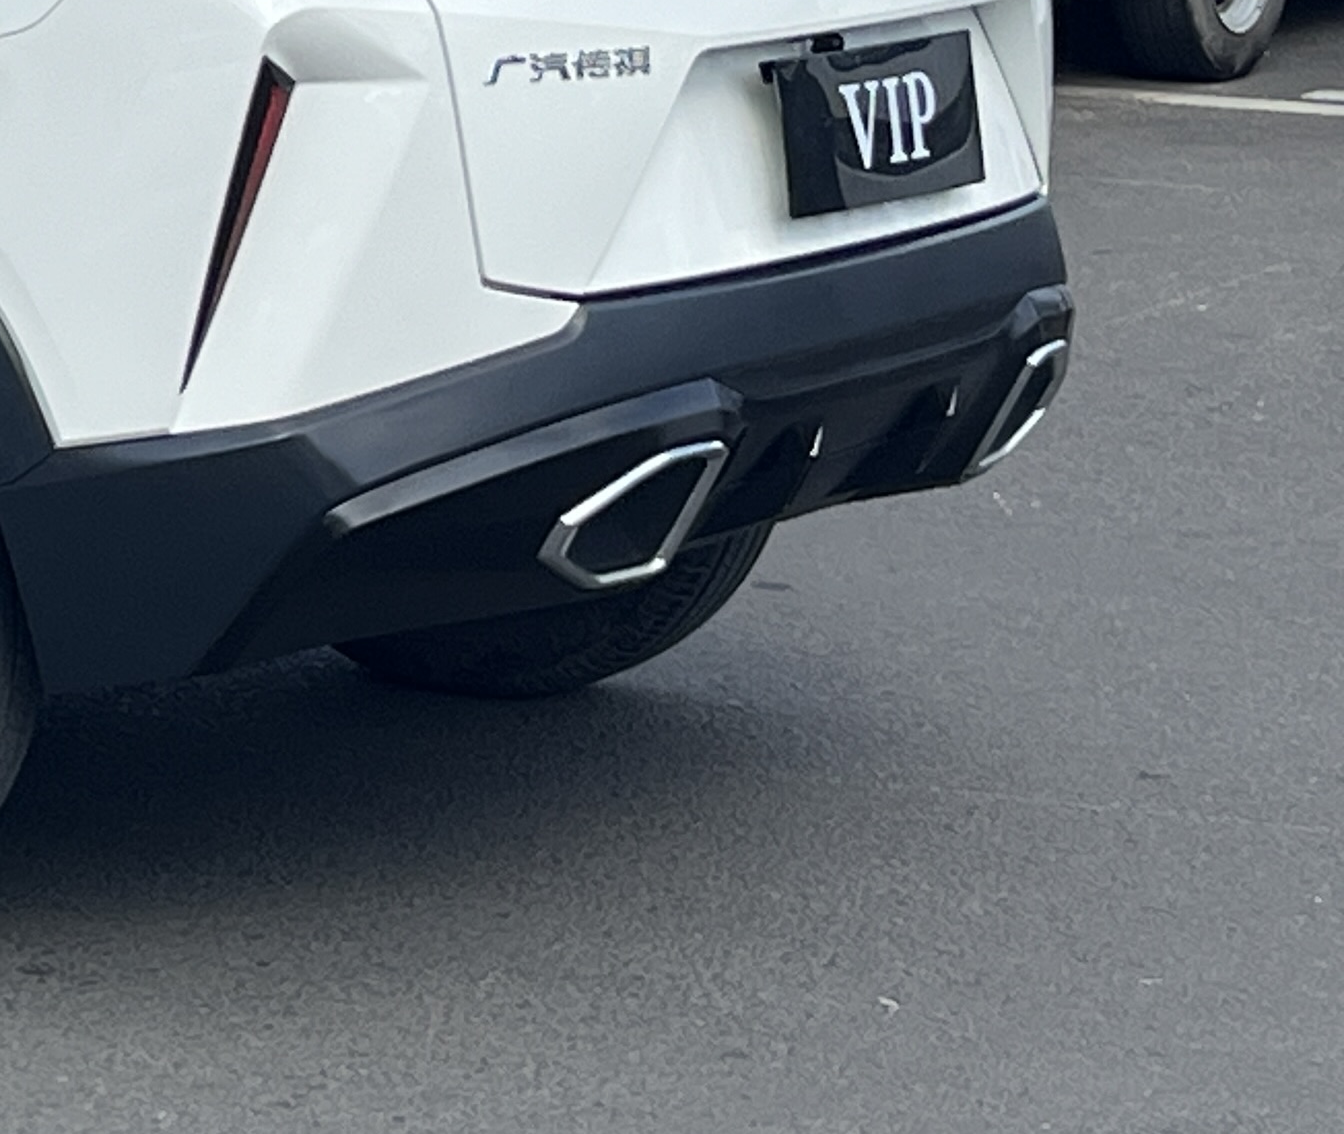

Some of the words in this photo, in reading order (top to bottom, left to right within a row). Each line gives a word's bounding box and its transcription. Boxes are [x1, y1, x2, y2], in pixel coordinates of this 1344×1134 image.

[483, 46, 650, 87] 广汽传祺
[837, 70, 937, 170] VIP
